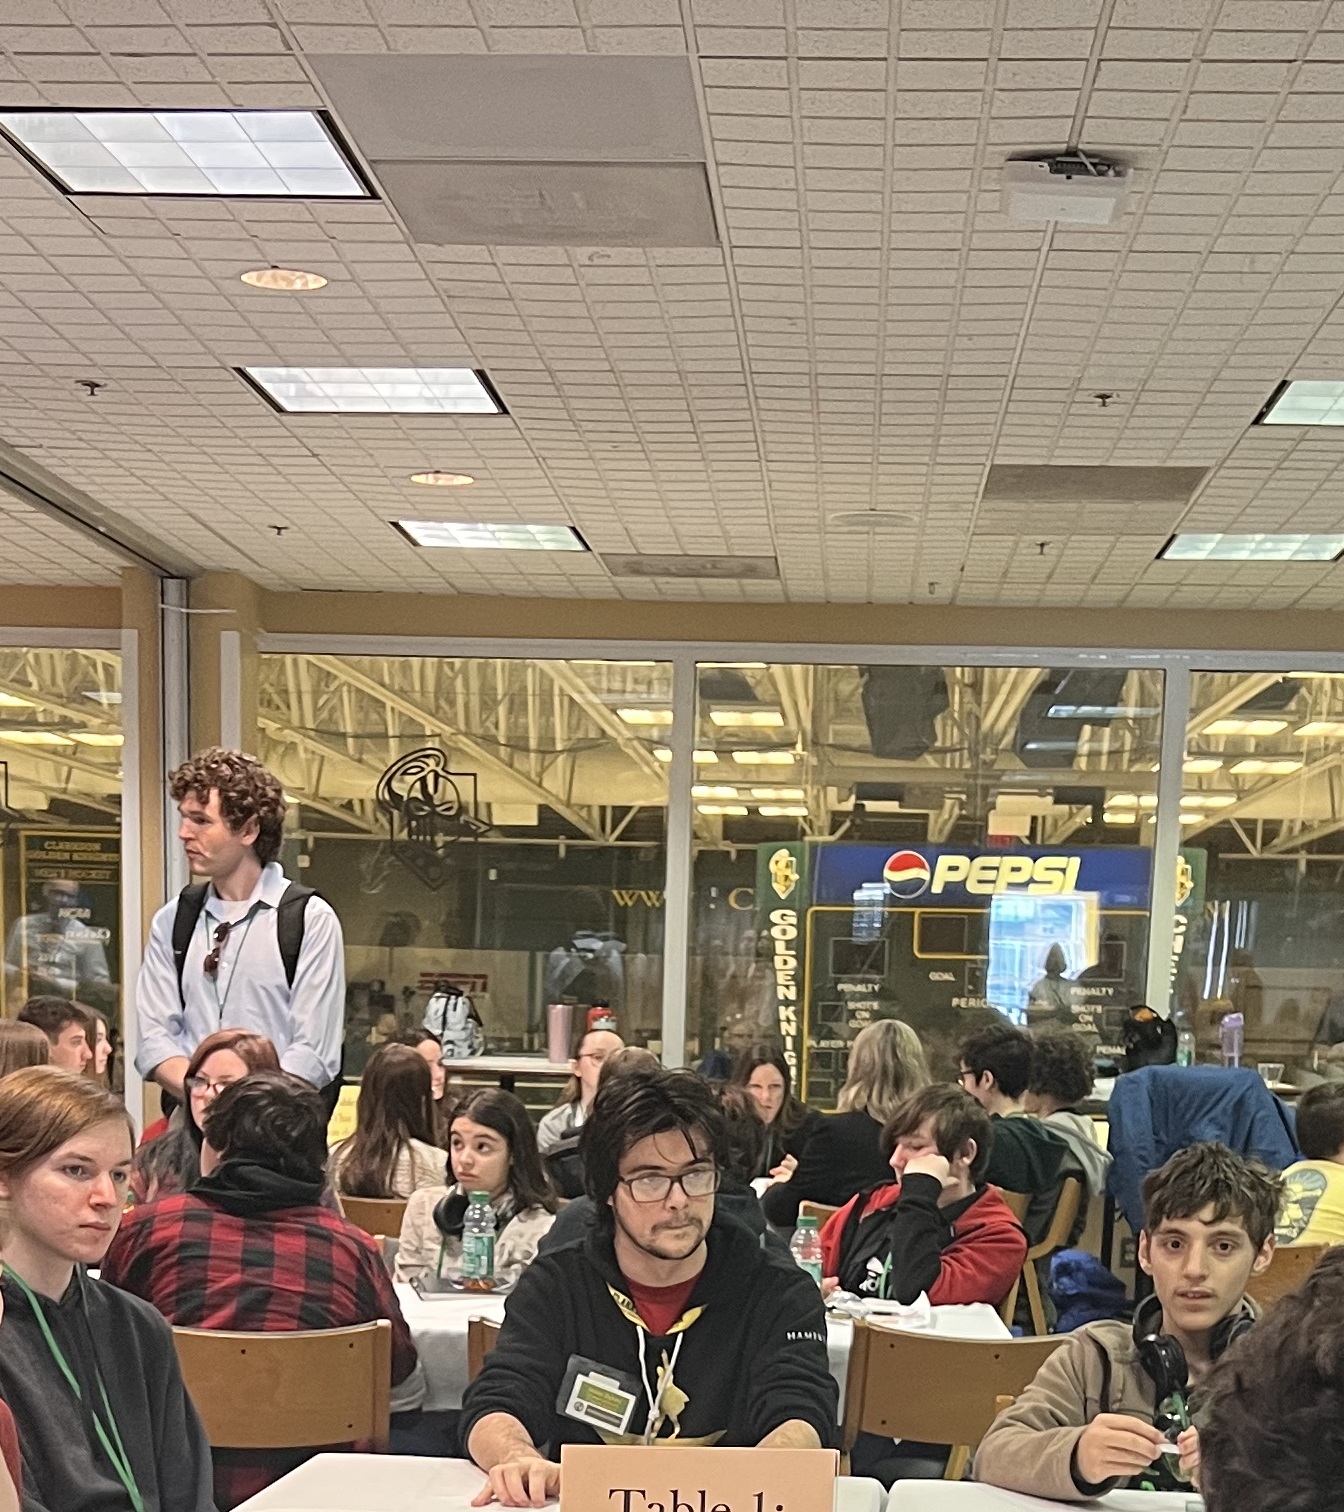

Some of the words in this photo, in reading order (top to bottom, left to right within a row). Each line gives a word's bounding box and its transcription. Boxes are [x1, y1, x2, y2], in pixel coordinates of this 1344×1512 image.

[930, 854, 1082, 895] PEPSI
[769, 909, 798, 1000] GOLDEN
[951, 997, 991, 1009] PERIO
[778, 1005, 798, 1095] KNIG
[1096, 1045, 1126, 1056] PENAL
